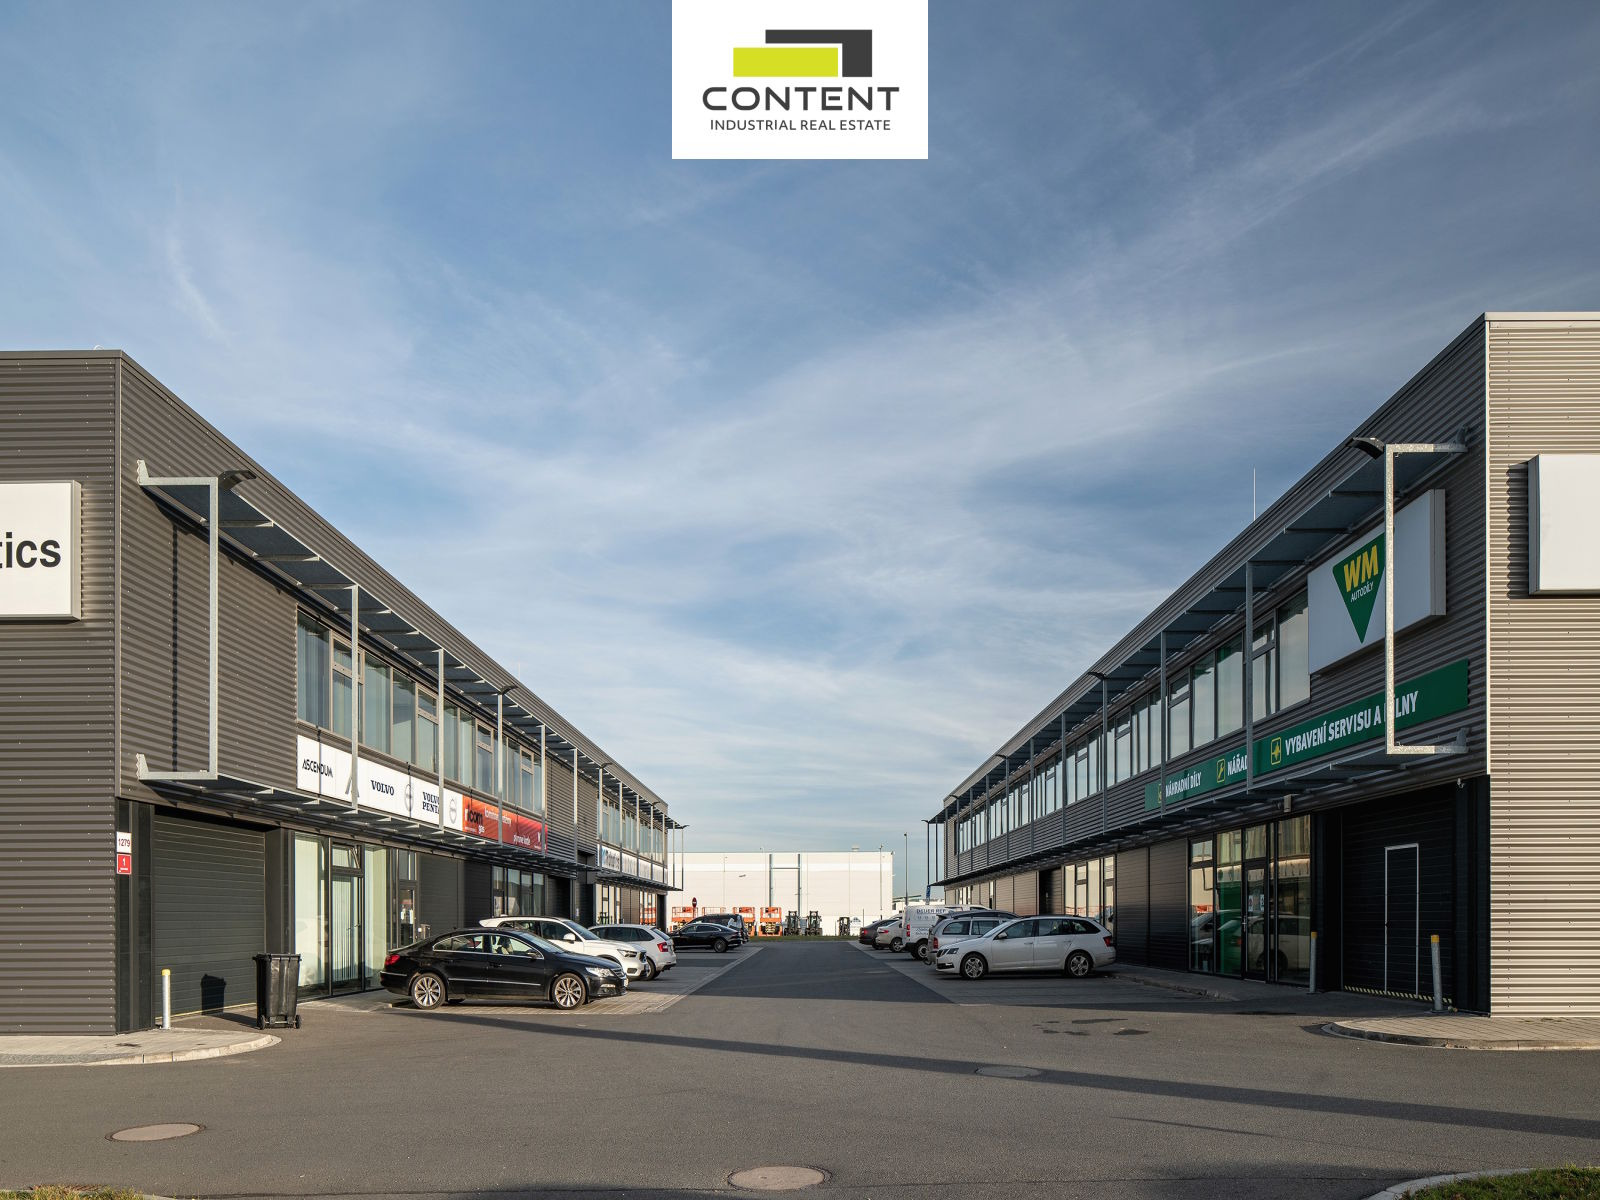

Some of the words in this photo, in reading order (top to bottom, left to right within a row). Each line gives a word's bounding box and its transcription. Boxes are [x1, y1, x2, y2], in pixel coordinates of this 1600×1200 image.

[0, 531, 61, 569] ics
[1343, 544, 1379, 593] WM
[1350, 580, 1374, 603] AUTODÍLY
[1285, 720, 1327, 756] VYBAVENÍ
[1328, 708, 1372, 741] SERVISU
[1373, 705, 1382, 726] A
[1384, 689, 1419, 722] LNY
[302, 758, 333, 778] ASCENDUM
[370, 779, 395, 796] VOLVO
[1165, 773, 1190, 798] NÁHRADNÍ
[1190, 771, 1202, 789] DÍLY
[118, 838, 130, 847] 1279
[122, 857, 126, 866] 1
